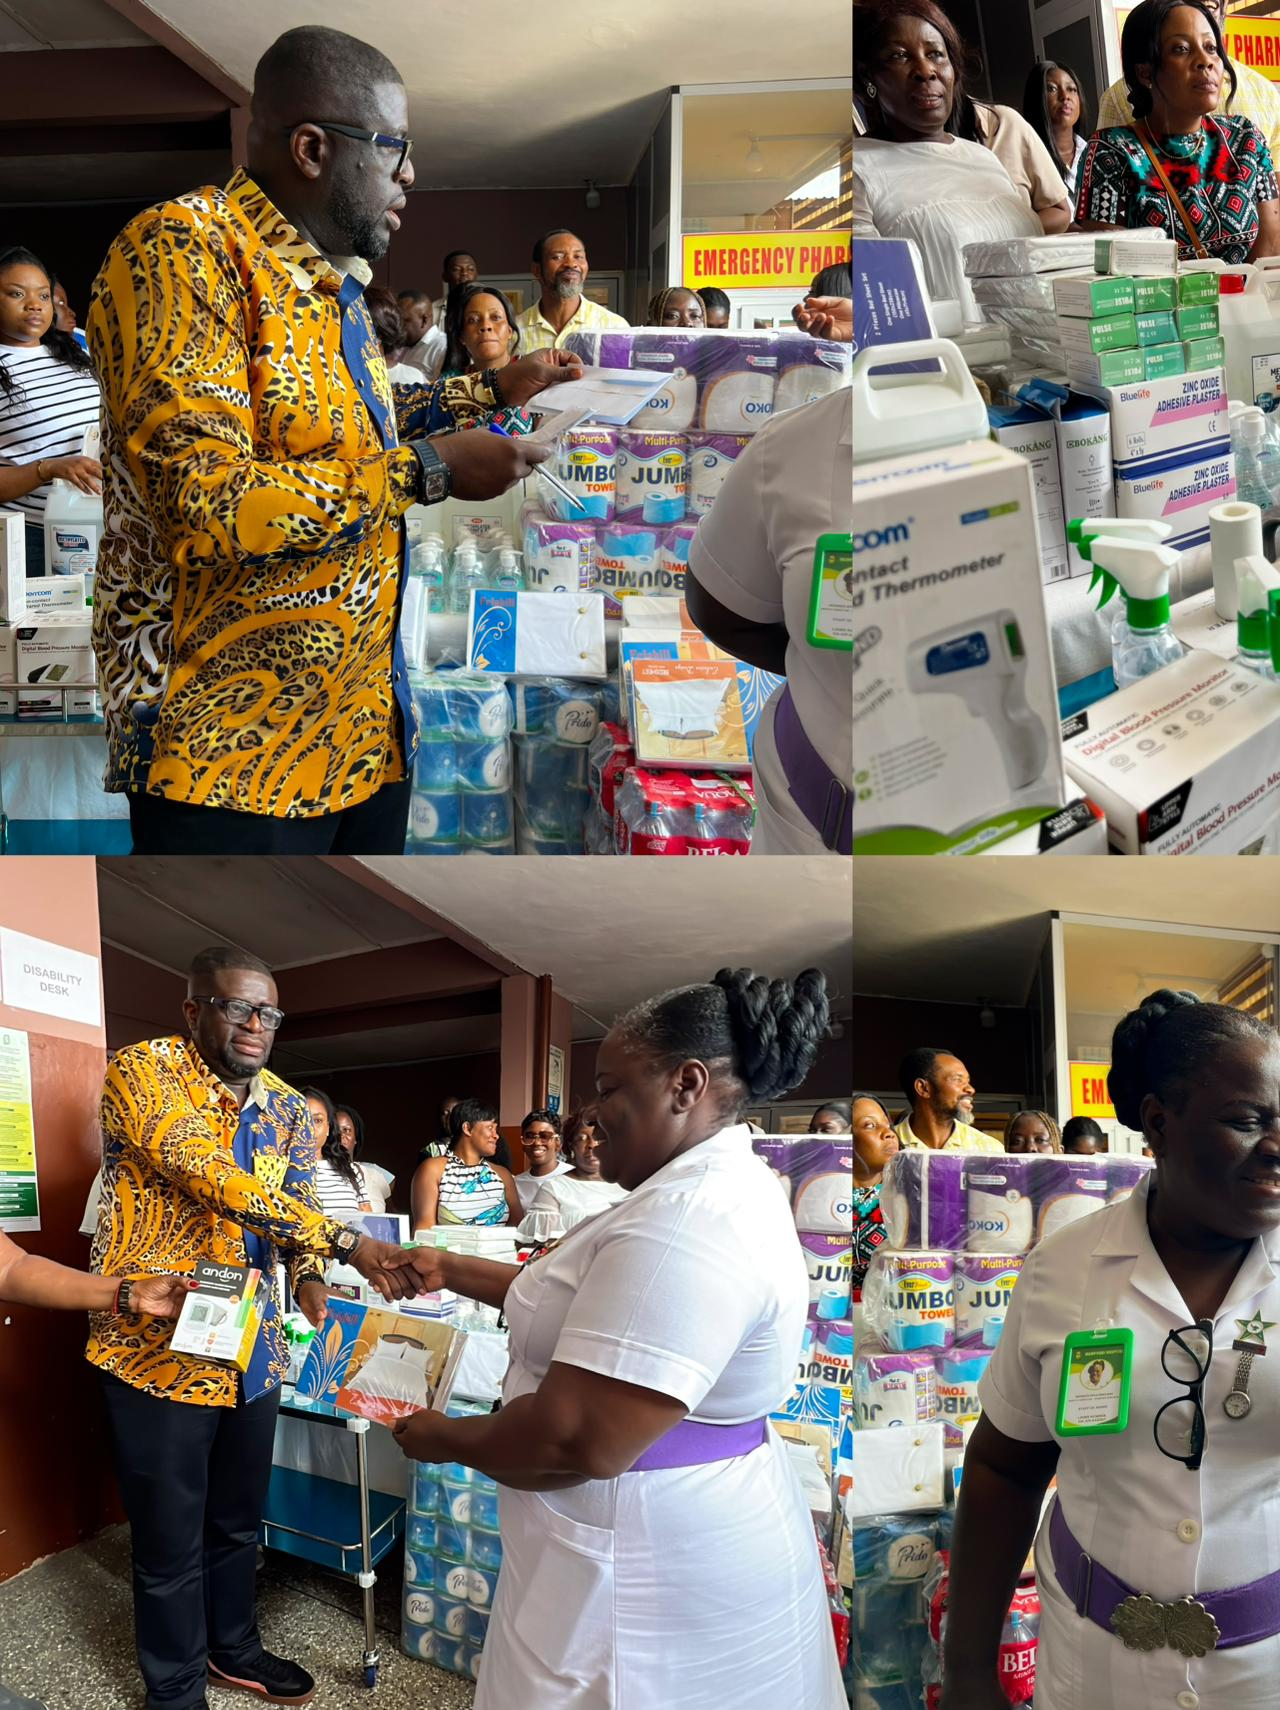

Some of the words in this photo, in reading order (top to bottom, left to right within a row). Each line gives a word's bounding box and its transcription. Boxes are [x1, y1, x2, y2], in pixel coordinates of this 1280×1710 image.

[694, 247, 795, 276] EMERGENCY
[799, 245, 852, 274] PHAR
[1092, 323, 1112, 334] PULSE
[1120, 389, 1151, 402] Bluelife
[1182, 380, 1198, 394] ZINC
[1200, 376, 1220, 390] OXIDE
[1157, 395, 1191, 413] ADHESIVE
[1192, 389, 1221, 405] PLASTER
[1194, 467, 1209, 481] ZINC
[1210, 461, 1229, 475] OXIDE
[1133, 480, 1164, 494] Bluelife
[1169, 483, 1201, 501] ADHESIVE
[1202, 474, 1230, 491] PLASTER
[872, 552, 1005, 602] Thermometer
[1081, 733, 1120, 756] Digital
[1120, 715, 1152, 736] Blood
[1150, 691, 1193, 718] Pressure
[1191, 669, 1229, 693] Monitor
[1196, 812, 1226, 841] Blood
[1227, 784, 1266, 818] Pressure
[1157, 832, 1182, 853] FULLY
[1181, 803, 1222, 836] AUTOMATIC
[23, 962, 83, 987] DISABILITY
[39, 982, 70, 997] DESK
[202, 1266, 244, 1283] andon
